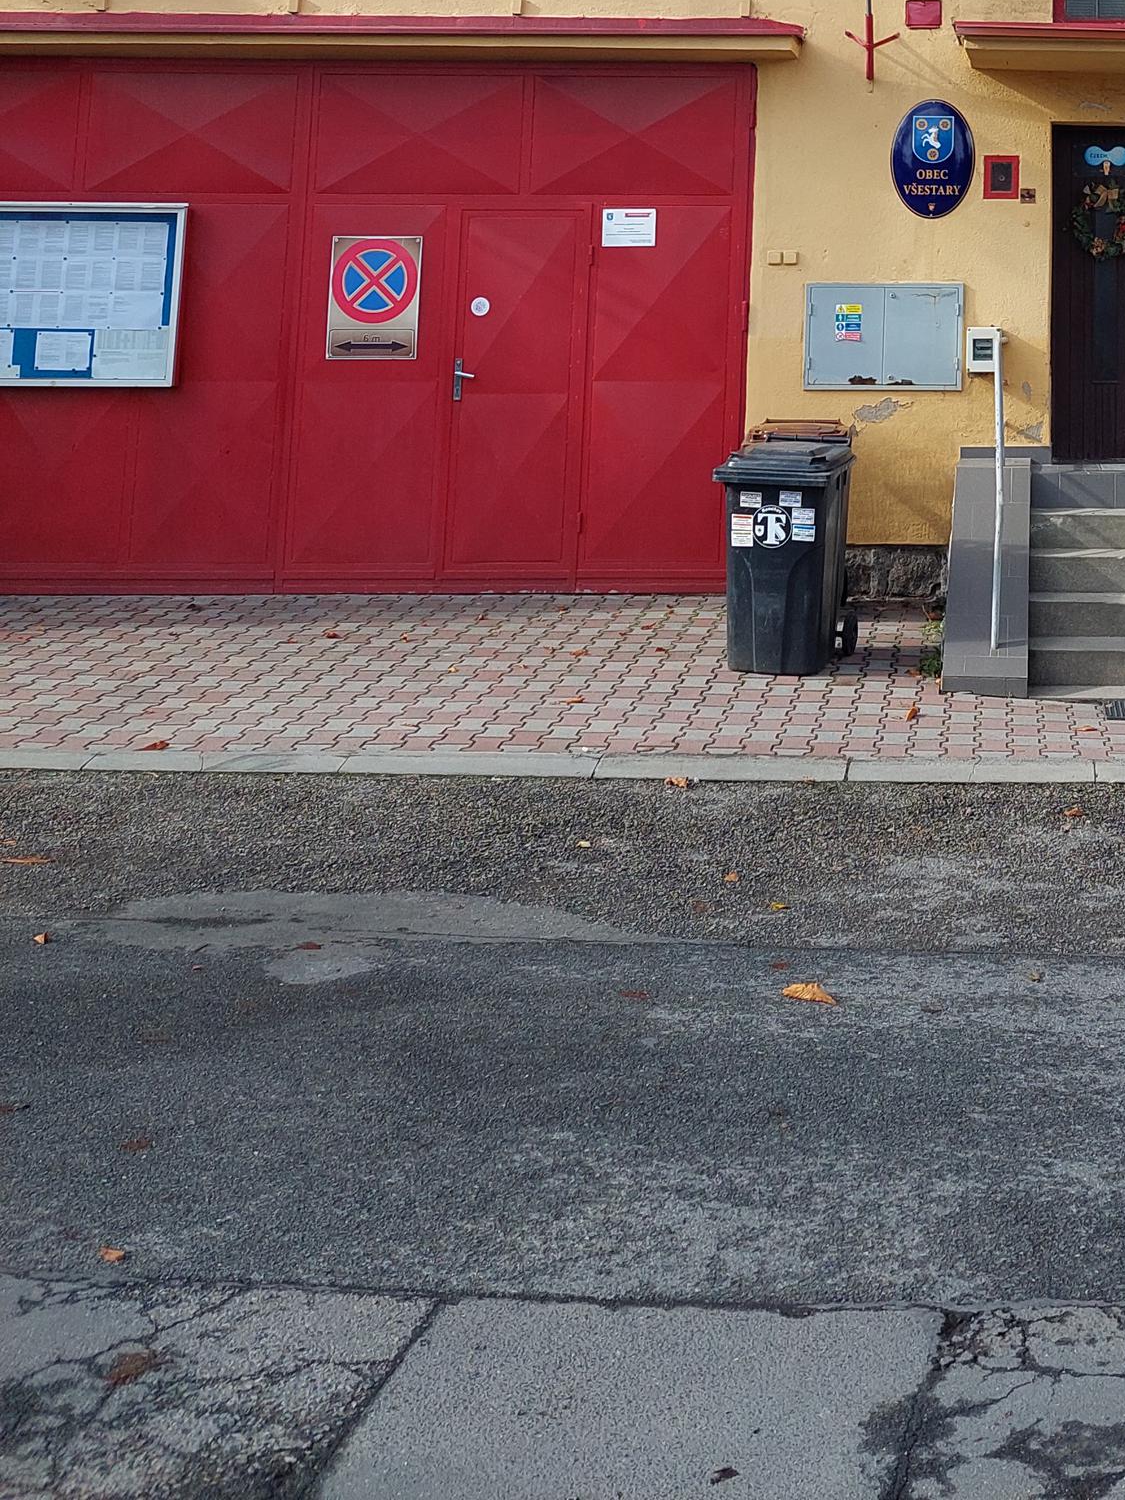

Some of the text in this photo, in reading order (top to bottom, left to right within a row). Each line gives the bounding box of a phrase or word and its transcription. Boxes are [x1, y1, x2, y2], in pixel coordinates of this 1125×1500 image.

[916, 169, 949, 180] OBEC
[903, 182, 961, 196] VŠESTARY
[363, 334, 369, 342] 6
